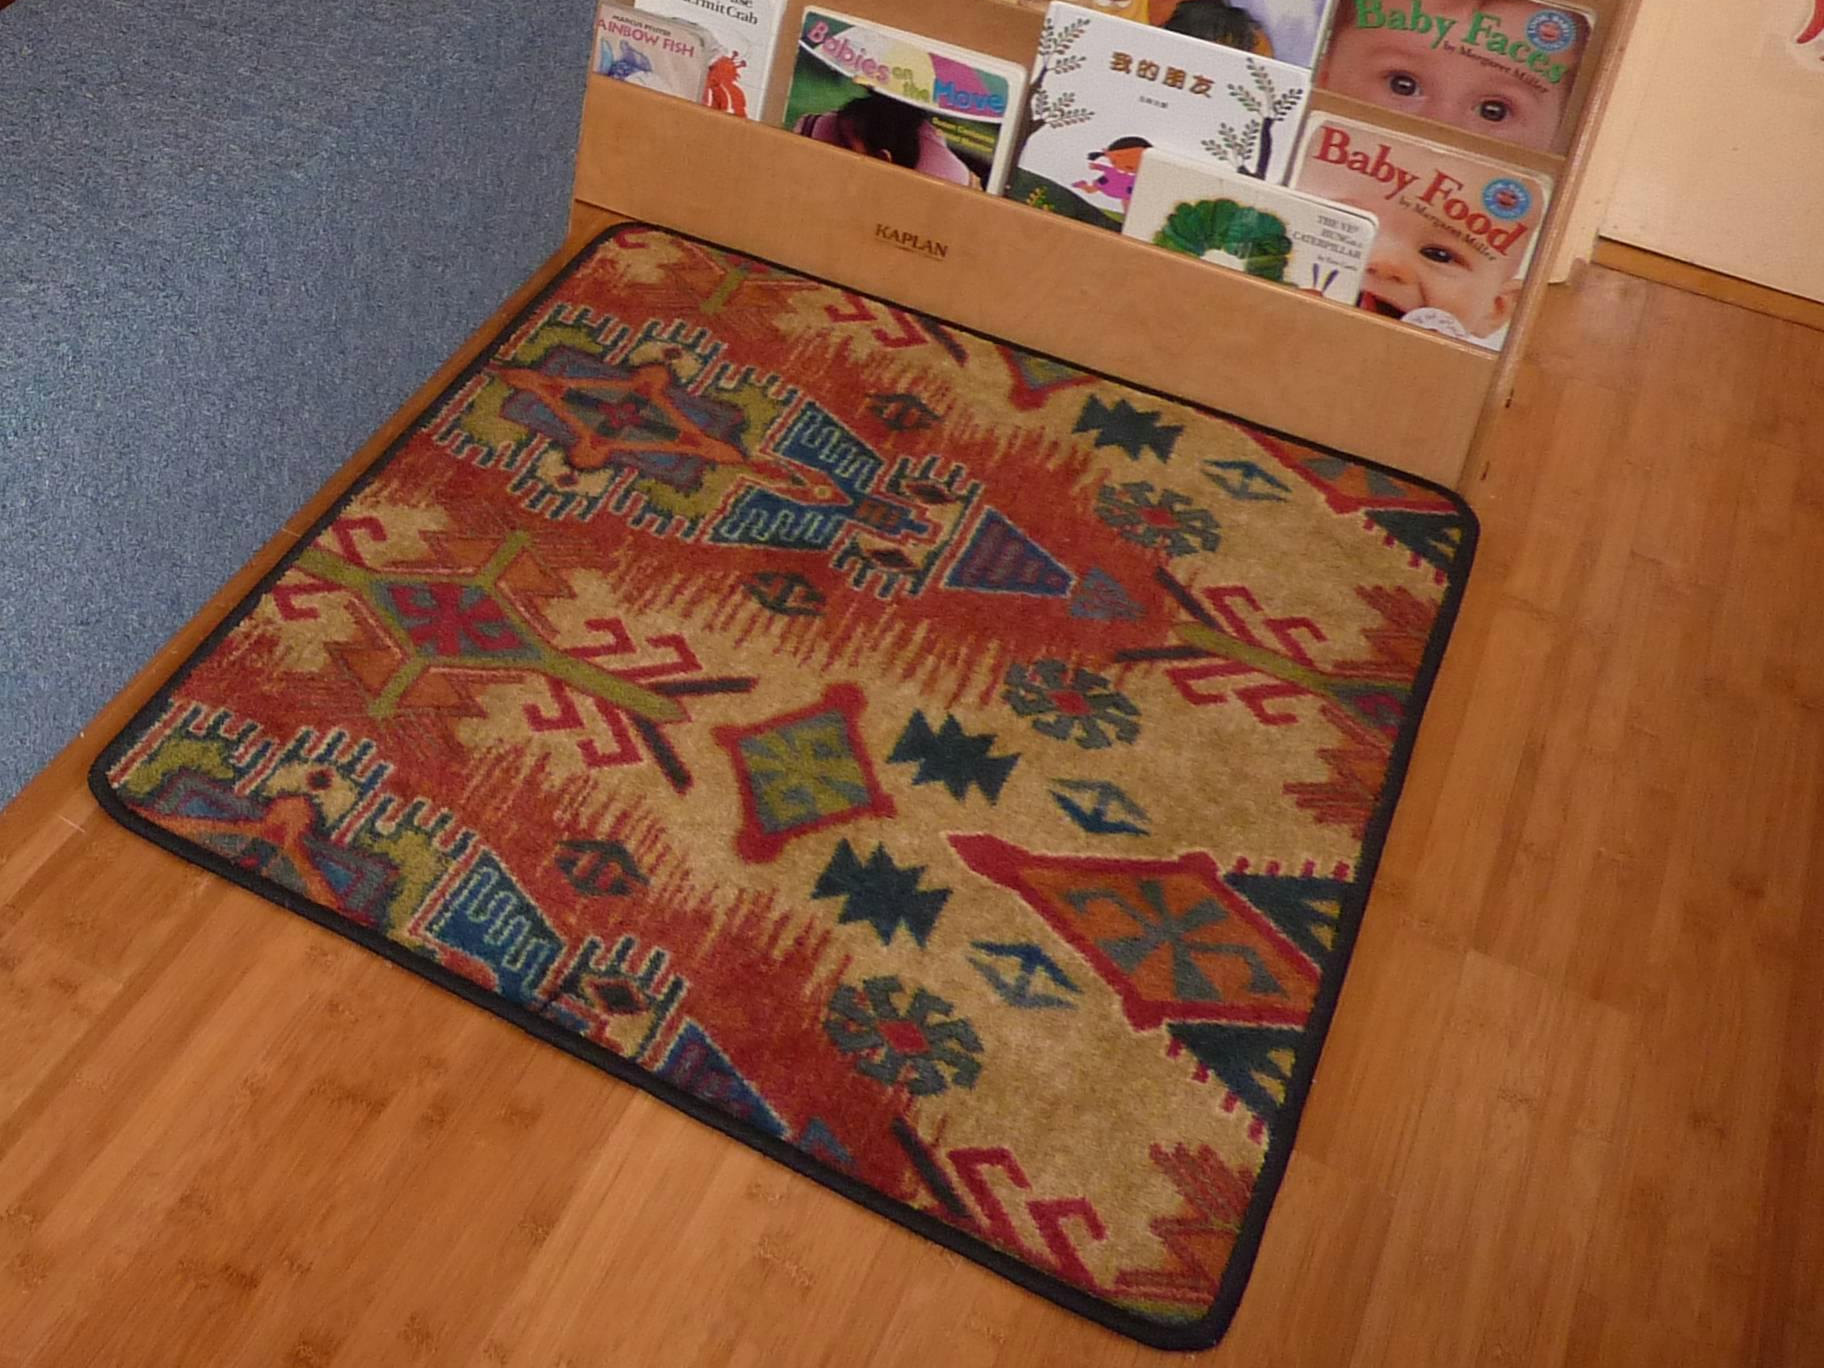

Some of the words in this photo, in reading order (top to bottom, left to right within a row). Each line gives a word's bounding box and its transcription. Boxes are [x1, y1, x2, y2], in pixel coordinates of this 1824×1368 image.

[727, 7, 758, 25] Crab
[596, 18, 660, 47] AINBOW
[662, 38, 696, 58] FISH
[807, 20, 891, 82] Babies
[1462, 11, 1569, 85] Faces
[1109, 50, 1216, 99] 我的朋友
[933, 78, 1006, 113] Move
[1312, 125, 1420, 201] Baby
[1419, 168, 1529, 257] Food
[875, 223, 949, 258] KAPLAN
[1464, 233, 1498, 262] Miller
